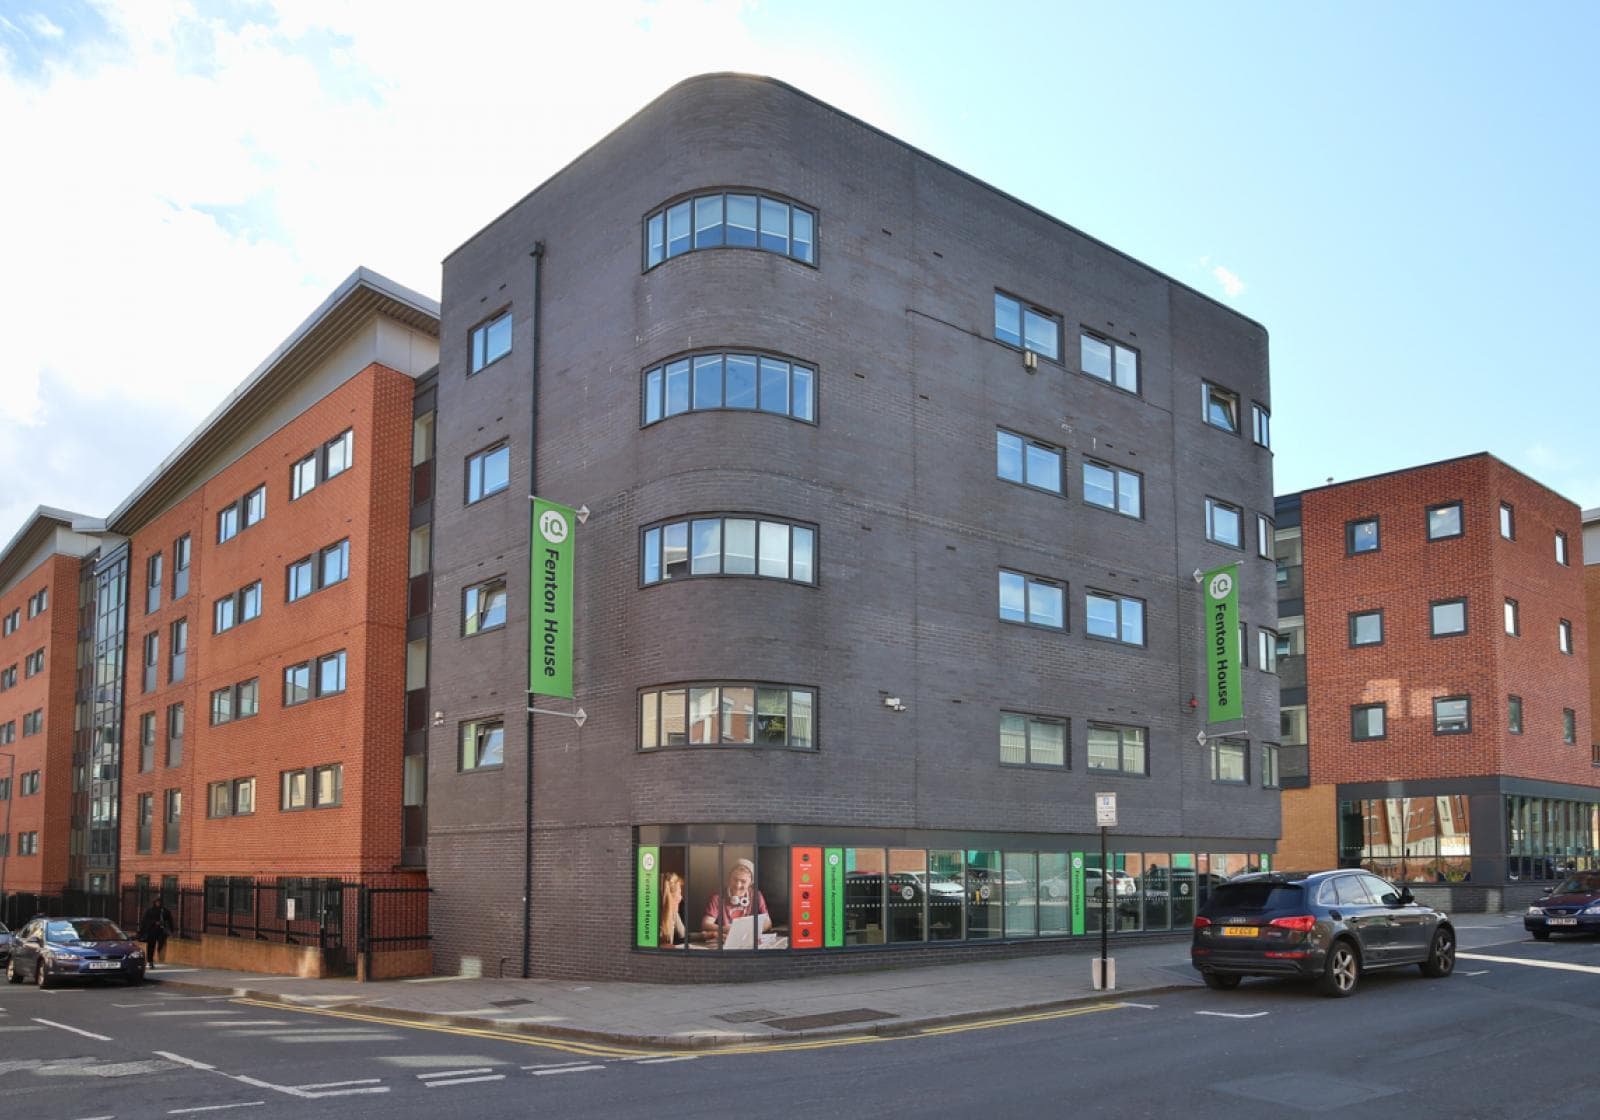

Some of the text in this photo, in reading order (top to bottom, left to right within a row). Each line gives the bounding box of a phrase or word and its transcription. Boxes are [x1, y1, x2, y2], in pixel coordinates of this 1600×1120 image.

[543, 548, 559, 677] Fenton House
[1215, 603, 1228, 707] Fenton House
